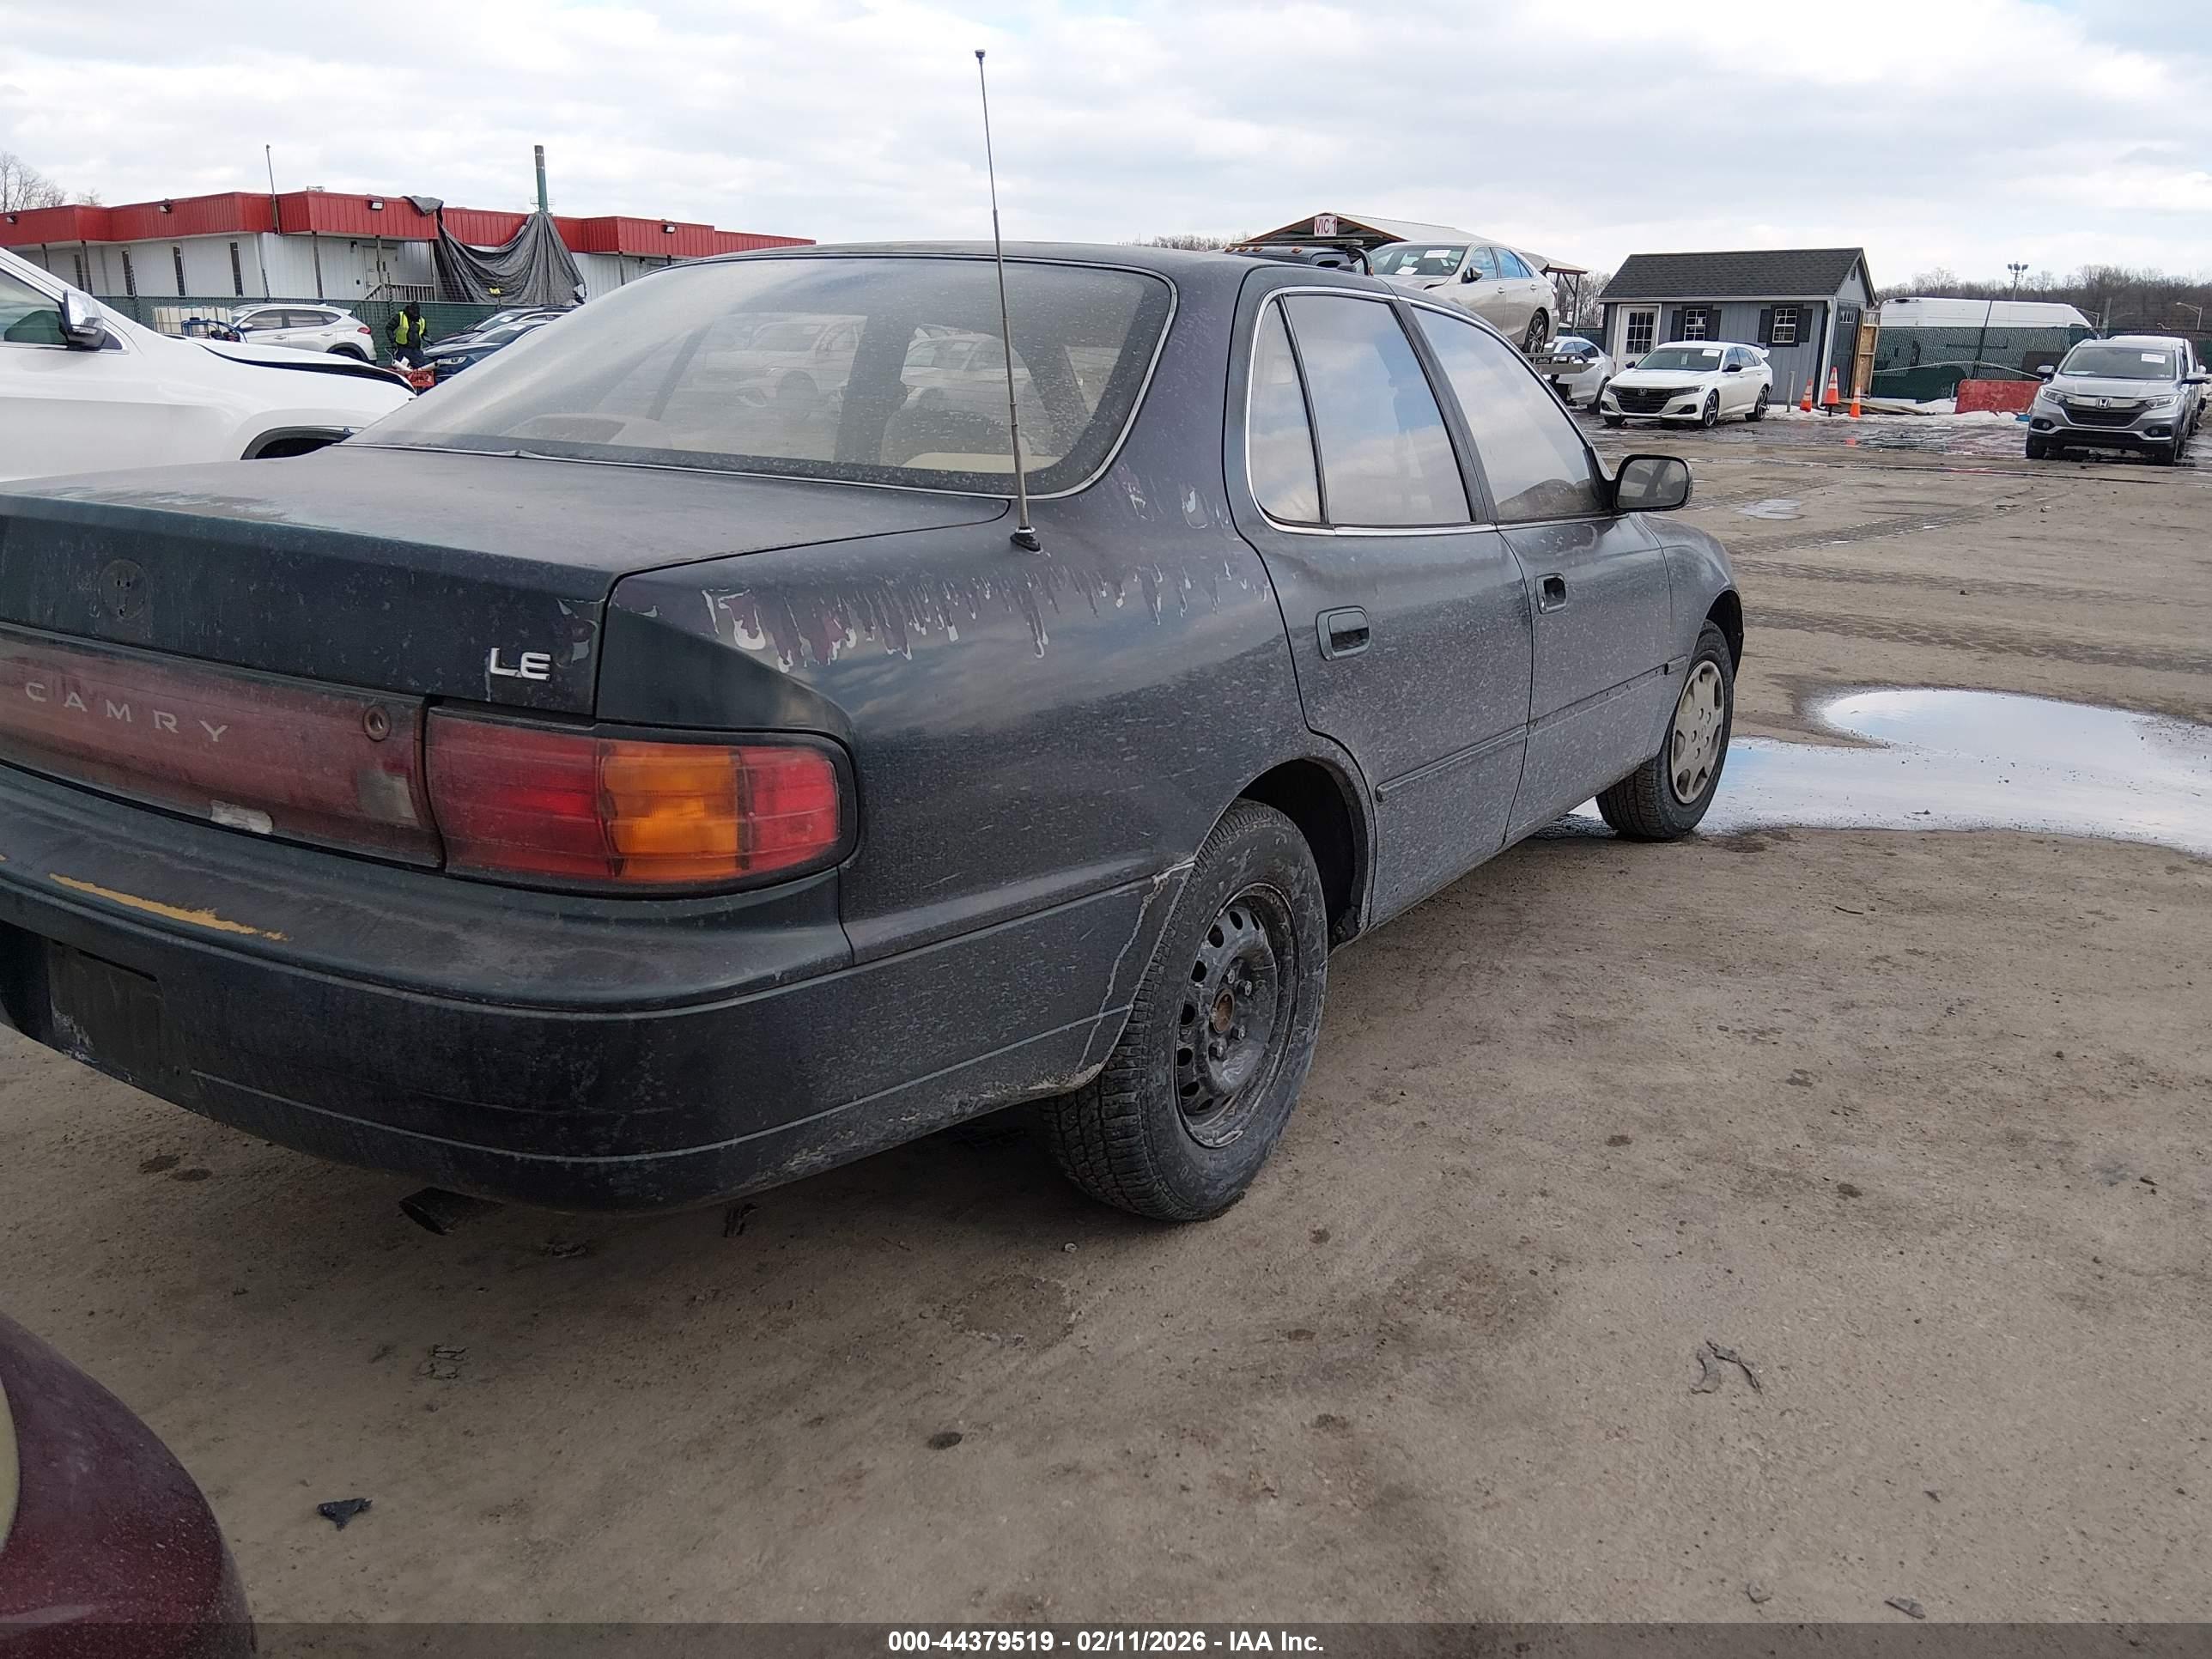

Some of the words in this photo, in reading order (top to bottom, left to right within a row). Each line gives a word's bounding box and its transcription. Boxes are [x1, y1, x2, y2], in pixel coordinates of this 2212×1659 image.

[1316, 218, 1330, 234] VIC
[1332, 218, 1337, 234] 1
[489, 647, 552, 682] LE
[25, 681, 229, 743] CAMRY
